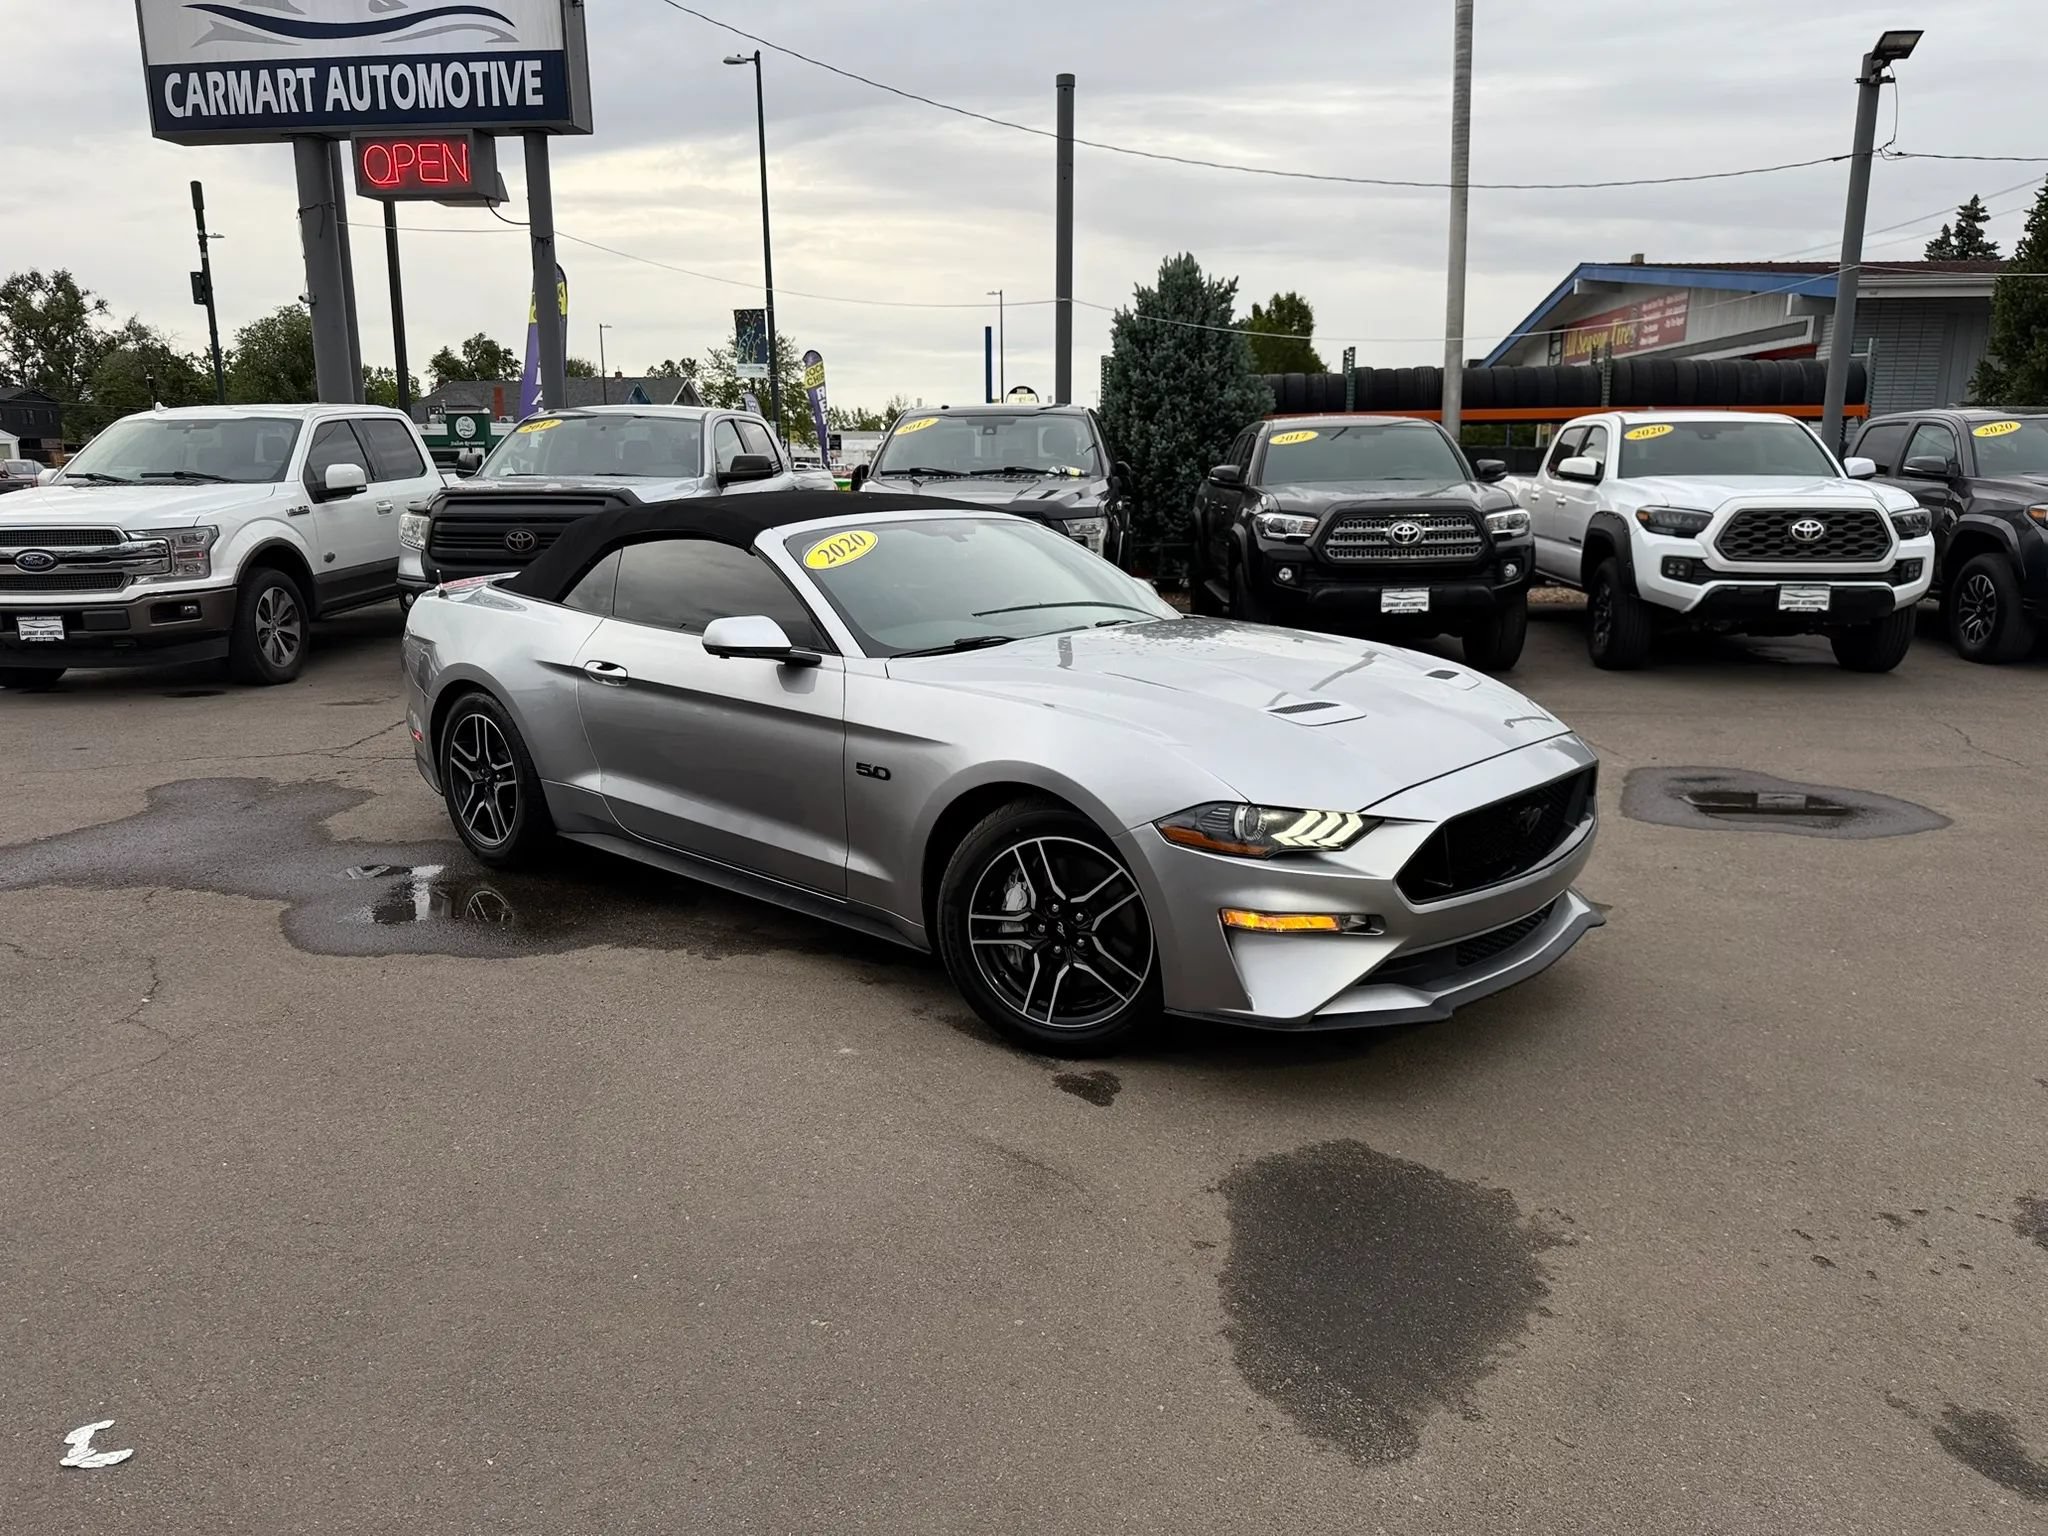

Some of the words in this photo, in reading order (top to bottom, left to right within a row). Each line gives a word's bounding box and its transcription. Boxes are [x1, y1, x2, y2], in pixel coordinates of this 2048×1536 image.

[164, 68, 316, 118] CARMART
[325, 60, 544, 112] AUTOMOTIVE
[363, 143, 471, 184] OPEN
[1635, 426, 1665, 438] 2020
[1984, 423, 2012, 435] 2020
[817, 533, 866, 564] 2020
[24, 555, 45, 565] Ford
